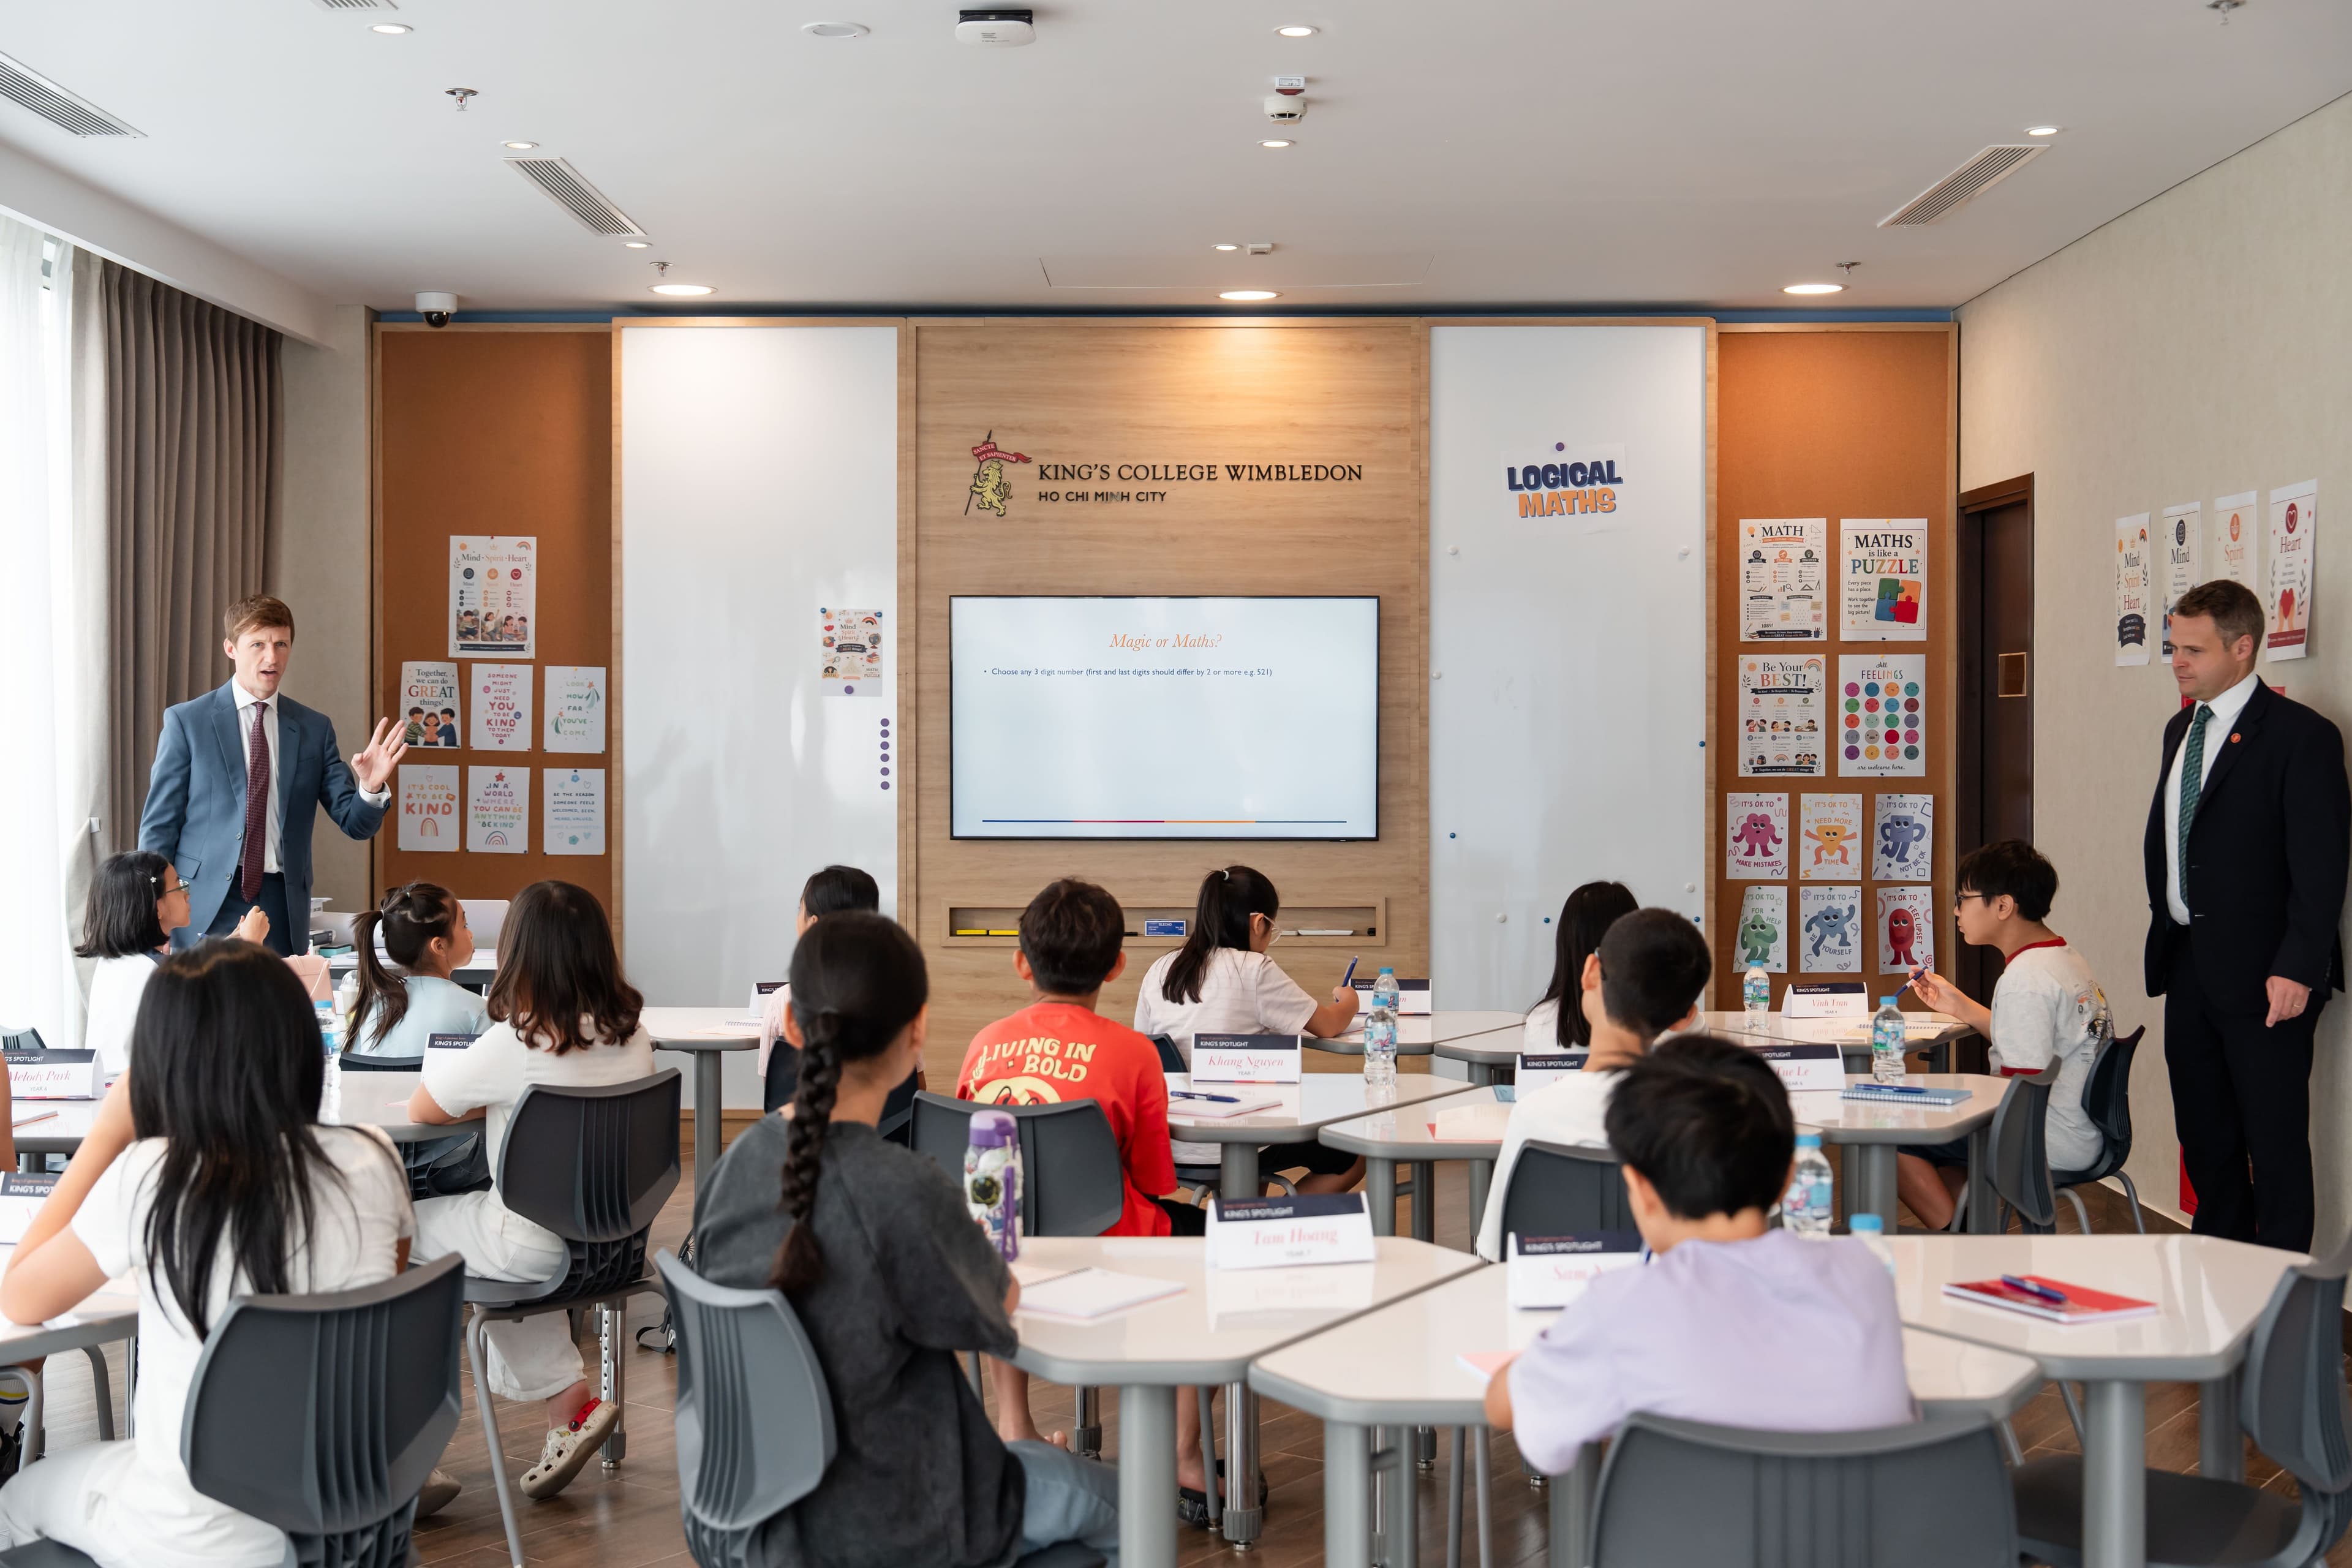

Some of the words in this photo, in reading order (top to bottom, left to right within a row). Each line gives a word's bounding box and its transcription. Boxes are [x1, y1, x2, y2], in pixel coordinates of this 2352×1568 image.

[973, 443, 995, 454] SANCTE
[987, 451, 1016, 462] SAPIENTER
[1038, 464, 1110, 481] KING'S
[1118, 464, 1218, 481] COLLEGE
[1225, 464, 1363, 481] WIMBLEDON
[1507, 460, 1623, 491] LOGICAL
[1039, 491, 1060, 502] HO
[1066, 491, 1088, 502] CHI
[1095, 491, 1130, 502] MINH
[1136, 491, 1167, 502] CITY
[1518, 488, 1617, 518] MATHS
[1762, 526, 1804, 537] MATH
[1855, 534, 1913, 549] MATHS
[2279, 536, 2302, 554] Heart
[484, 553, 503, 563] Spirit
[508, 554, 527, 562] Heart
[2124, 551, 2140, 568] Mind
[2171, 546, 2190, 565] Mind
[2224, 543, 2244, 566] Spirit
[1851, 559, 1919, 574] PUZZLE
[2124, 573, 2140, 590] Spirit
[2124, 594, 2140, 611] Heart
[1110, 633, 1152, 652] Magic
[1156, 638, 1169, 647] or
[1172, 633, 1222, 648] Maths?
[416, 668, 448, 677] Together,
[1041, 668, 1055, 677] digit
[1086, 668, 1102, 677] (first
[1132, 668, 1150, 677] digits
[1196, 668, 1205, 677] by
[1257, 668, 1273, 677] 521)
[1763, 662, 1776, 672] Be
[1779, 662, 1804, 672] Your
[1760, 673, 1807, 687] BEST!
[1861, 670, 1904, 679] FEELINGS
[408, 685, 454, 698] GREAT
[420, 698, 444, 707] things!
[489, 701, 514, 710] YOU
[405, 802, 452, 815] KIND
[1735, 858, 1752, 867] MAKE
[1899, 865, 1913, 874] NOT
[1912, 858, 1921, 867] BE
[1918, 850, 1926, 859] OK
[1766, 916, 1782, 925] HELP
[1908, 905, 1918, 922] FEEL
[1915, 923, 1923, 945] UPSET
[1809, 933, 1818, 943] BE
[1822, 944, 1853, 956] YOURSELF
[983, 1036, 1061, 1062] LIVING
[1064, 1042, 1097, 1063] IN
[1022, 1054, 1088, 1083] BOLD
[1208, 1056, 1244, 1069] Khang
[1247, 1056, 1284, 1069] Nguyen
[9, 1071, 44, 1082] Melody
[47, 1069, 70, 1082] Park
[10, 1185, 34, 1194] KING'S
[1224, 1208, 1251, 1219] KING'S
[1251, 1206, 1294, 1218] SPOTLIGHT
[1290, 1228, 1338, 1245] Hoang
[1525, 1242, 1555, 1253] KING'S
[1555, 1240, 1603, 1252] SPOTLIGHT
